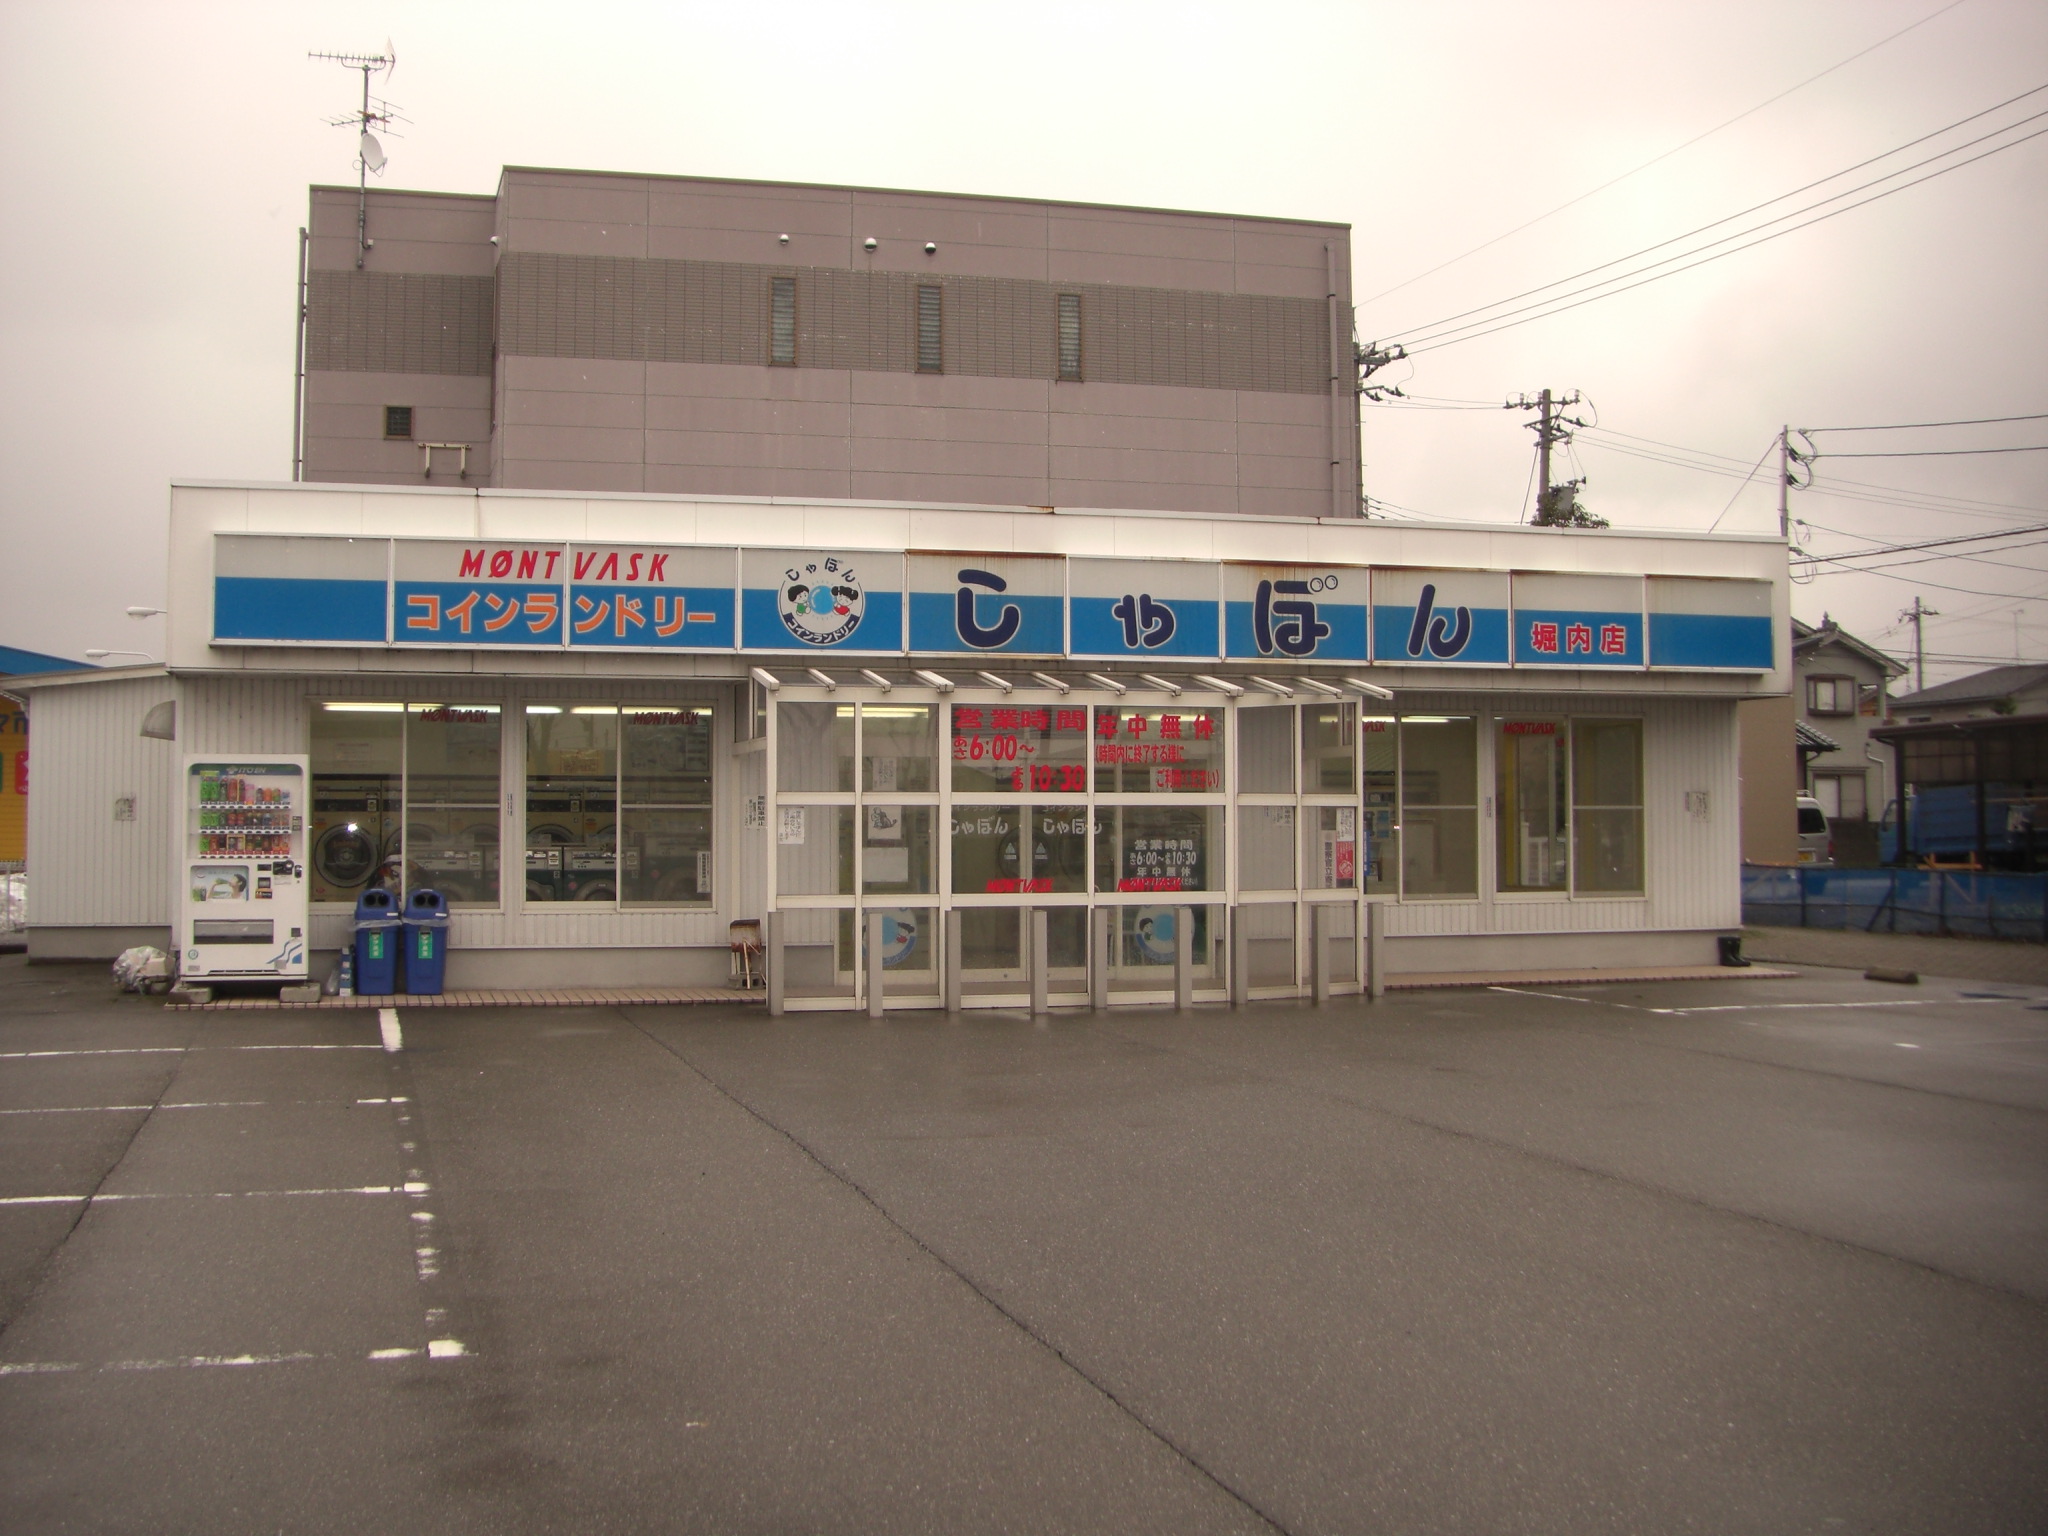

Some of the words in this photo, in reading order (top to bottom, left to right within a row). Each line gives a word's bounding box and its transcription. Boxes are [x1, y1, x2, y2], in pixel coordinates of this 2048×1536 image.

[573, 551, 670, 582] VASK
[785, 557, 856, 583] しゃぼん
[407, 590, 716, 638] コインランドリー
[955, 568, 1472, 659] しゃぼん
[787, 619, 855, 643] コインランドリー
[1531, 621, 1626, 655] 堀内店
[953, 708, 1087, 732] 営業時間
[1096, 713, 1216, 740] 年中無休
[1134, 839, 1194, 851] 営業時間
